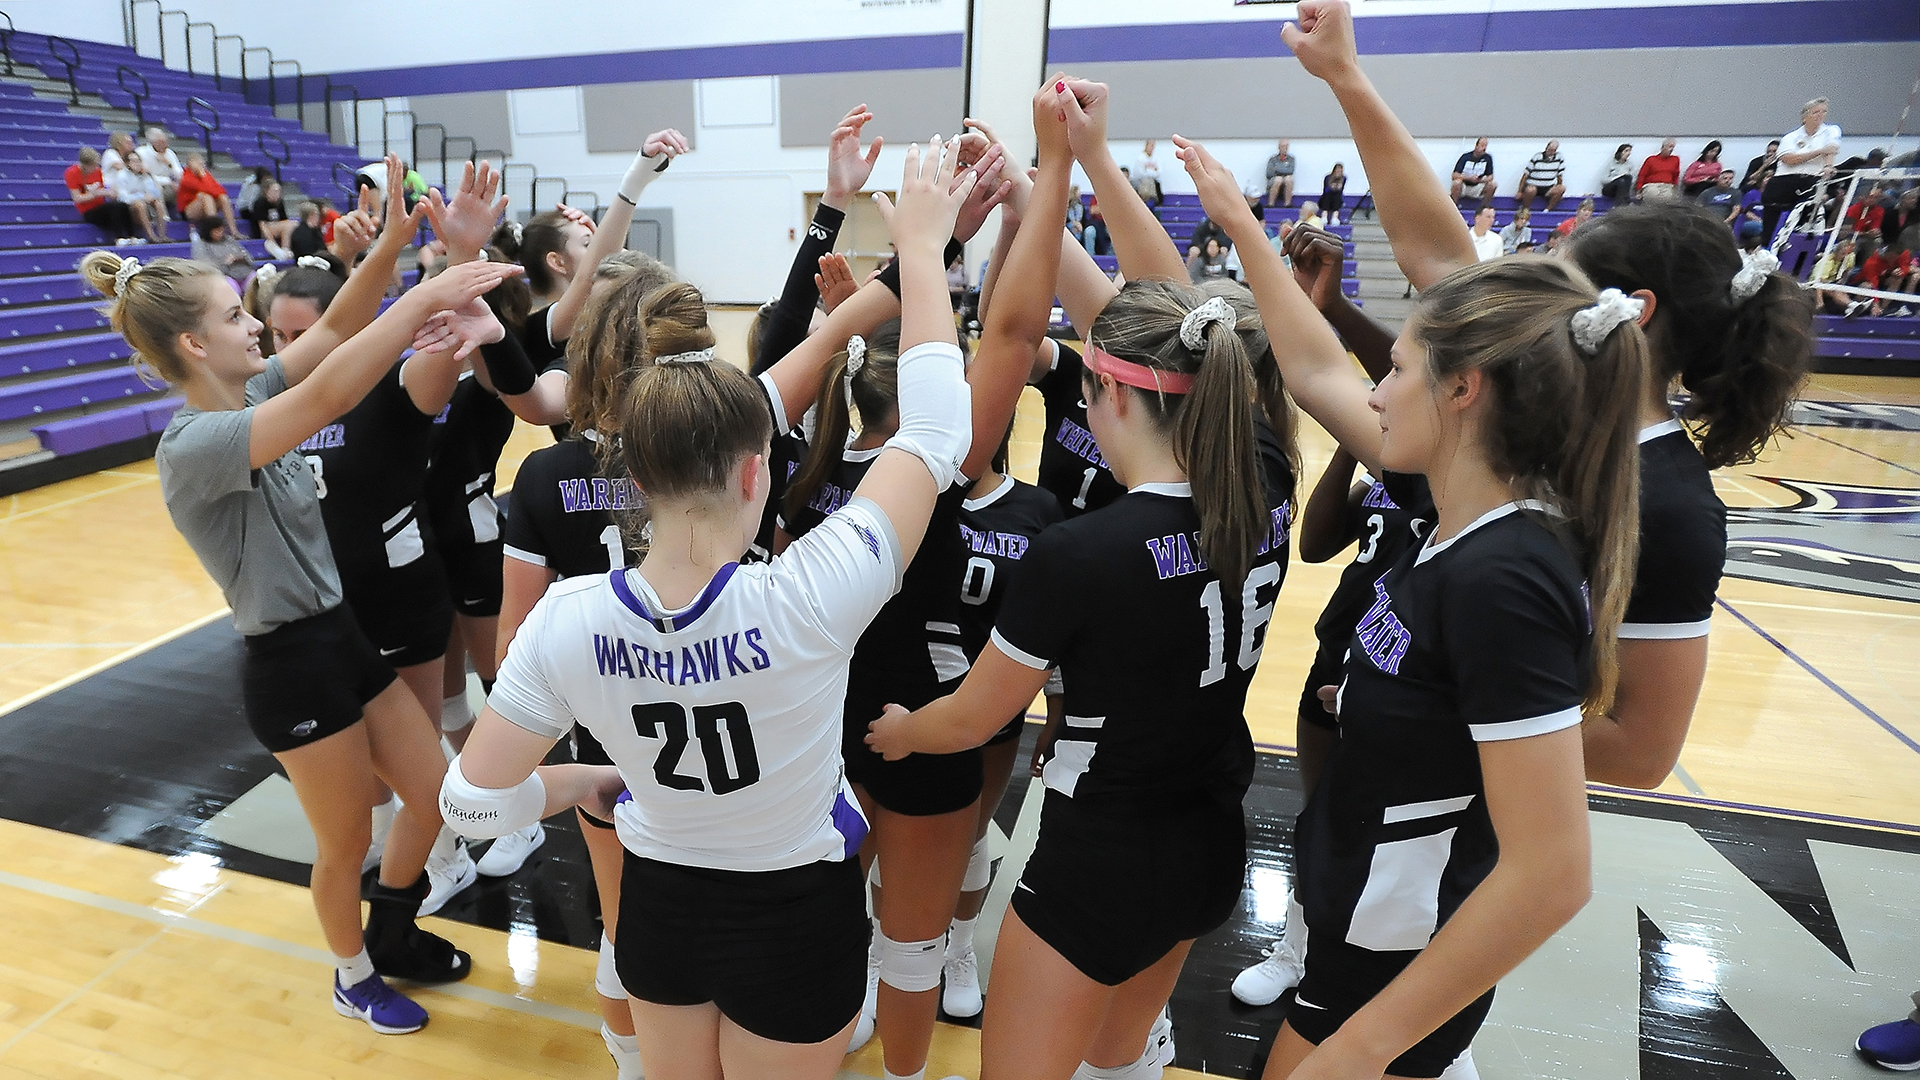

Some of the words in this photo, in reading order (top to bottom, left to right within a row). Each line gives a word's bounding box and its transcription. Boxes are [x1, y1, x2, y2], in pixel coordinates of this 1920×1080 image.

[1357, 513, 1384, 563] 3
[960, 556, 996, 606] 0
[1199, 560, 1281, 688] 16
[592, 627, 772, 687] WARHAWKS
[630, 700, 762, 796] 20
[446, 798, 499, 821] Tandem
